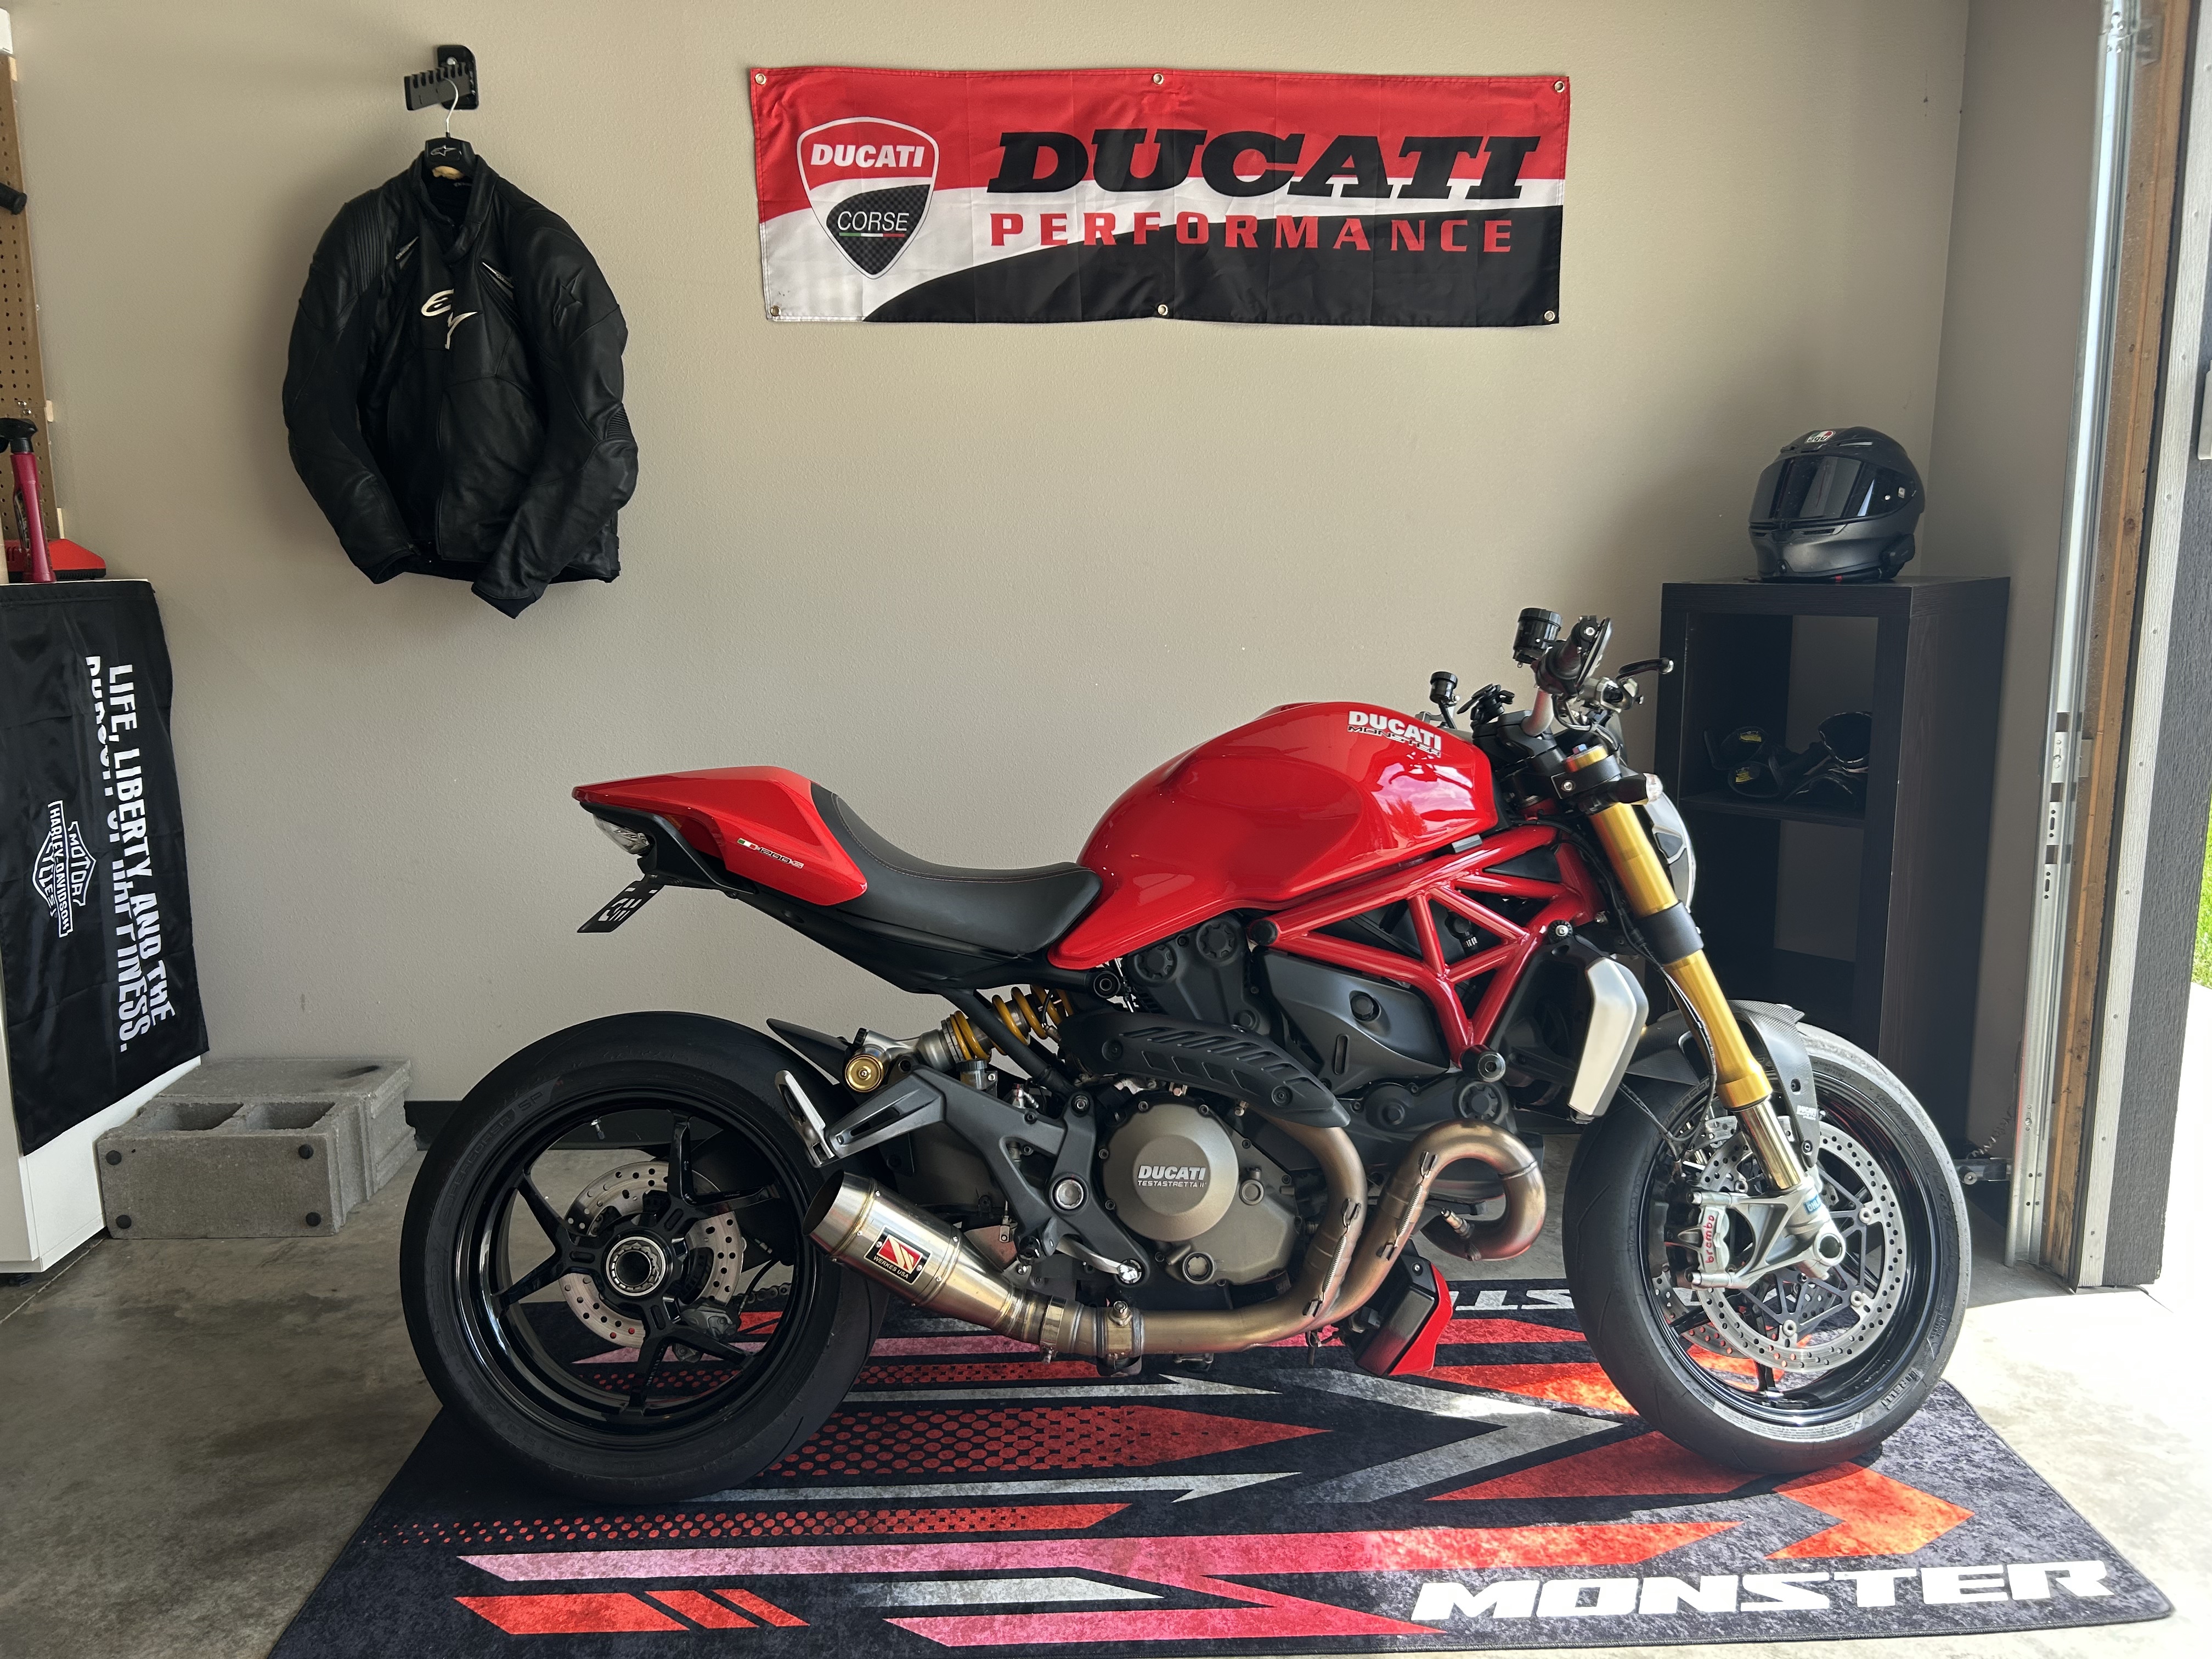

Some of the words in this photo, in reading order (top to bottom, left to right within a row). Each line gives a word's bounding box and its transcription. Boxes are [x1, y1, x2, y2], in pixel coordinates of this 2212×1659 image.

[810, 144, 925, 168] DUCATI
[987, 128, 1541, 199] DUCATI
[837, 211, 910, 232] CORSE
[990, 211, 1512, 253] PERFORMANCE
[1347, 726, 1441, 758] MONSTER
[1348, 711, 1441, 751] DUCATI
[69, 834, 91, 896] MOTOR
[109, 664, 137, 742] LIFE,
[130, 893, 162, 960] AND
[146, 960, 176, 1026] THE
[50, 807, 69, 930] HARLEY-DAVIDSON
[1138, 1165, 1206, 1181] DUCATI
[1703, 1215, 1715, 1264] brembo
[873, 1255, 898, 1272] WERKES
[897, 1269, 909, 1279] USA
[1412, 1560, 2115, 1621] MONSTER
